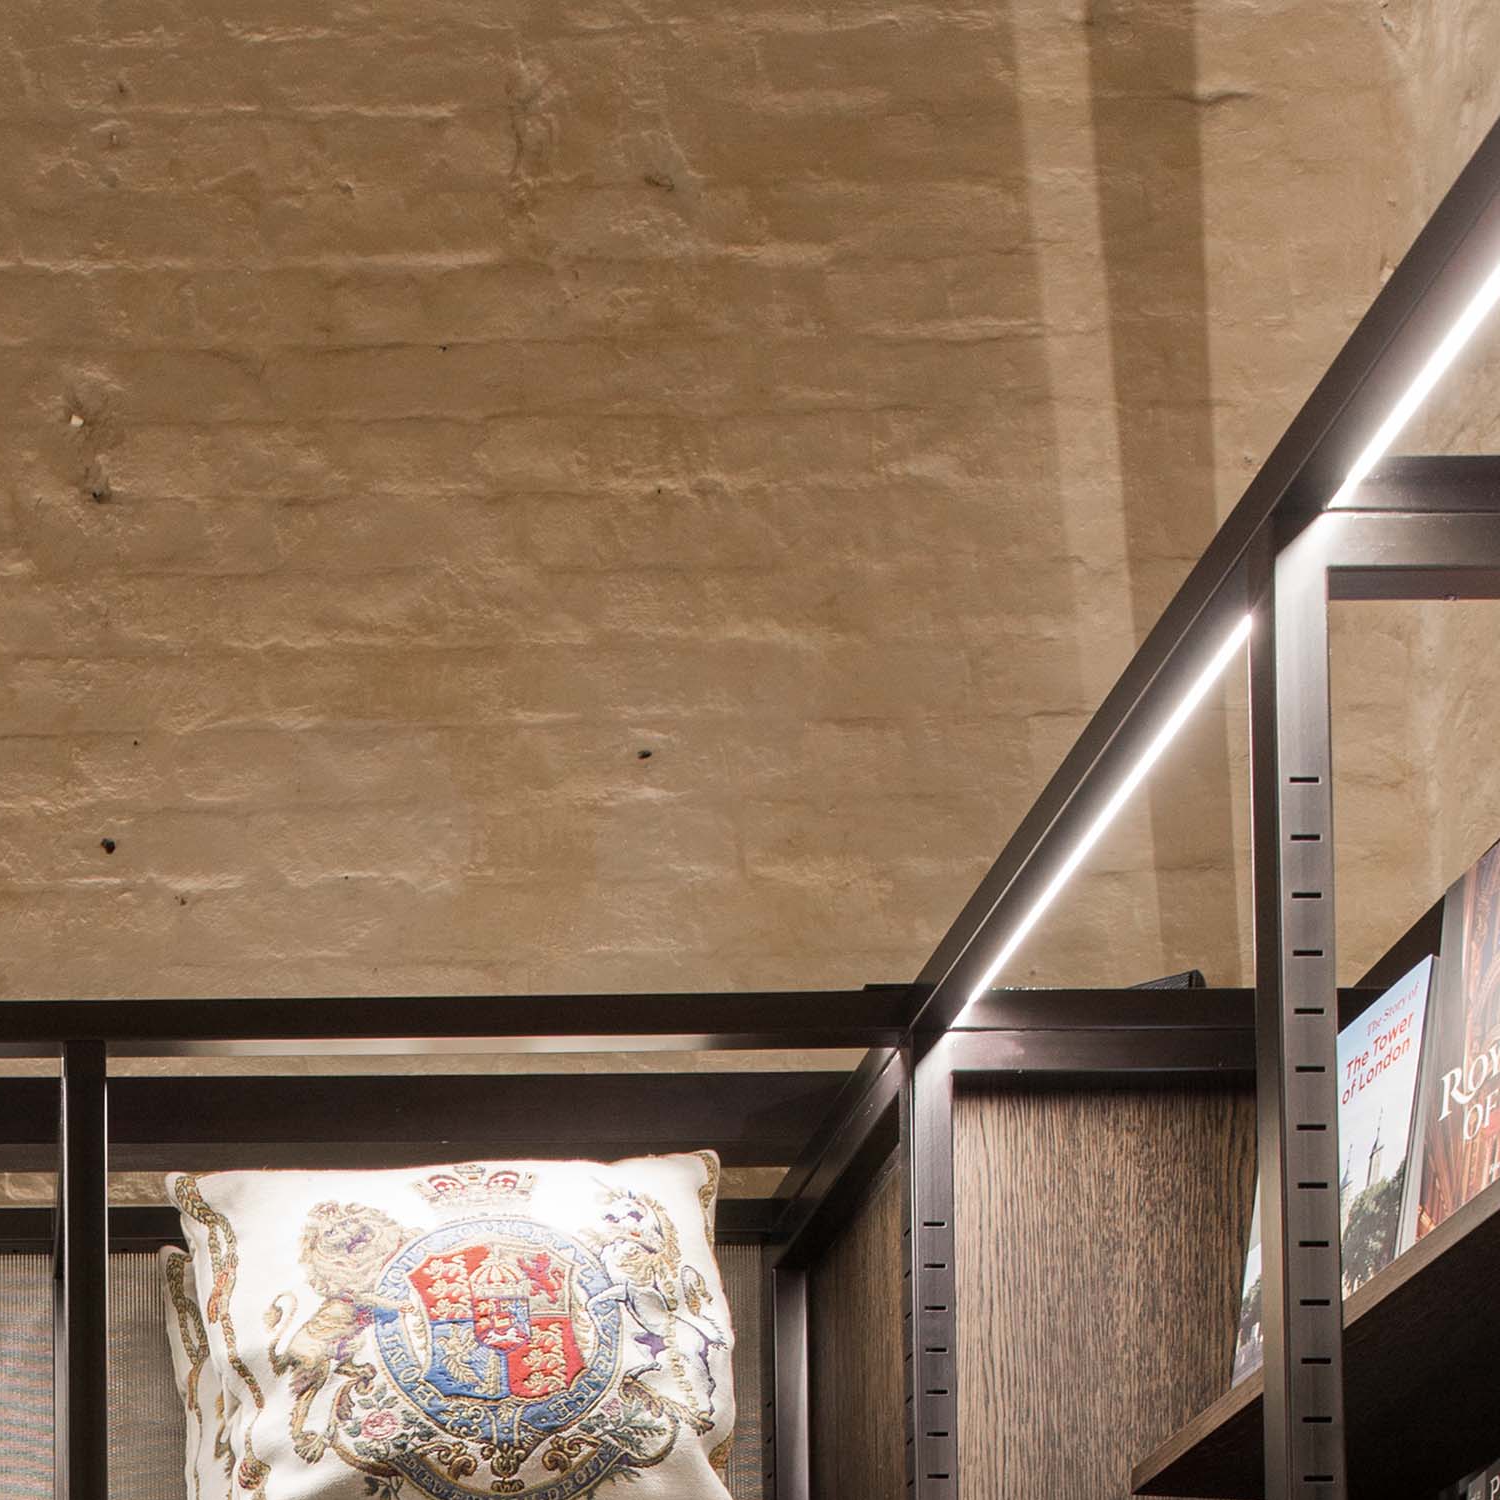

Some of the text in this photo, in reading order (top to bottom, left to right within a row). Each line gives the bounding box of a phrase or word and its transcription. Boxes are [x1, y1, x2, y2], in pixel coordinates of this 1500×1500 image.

[1342, 1037, 1411, 1105] of London
[1346, 1011, 1414, 1080] The Tower
[1462, 1087, 1500, 1142] OF
